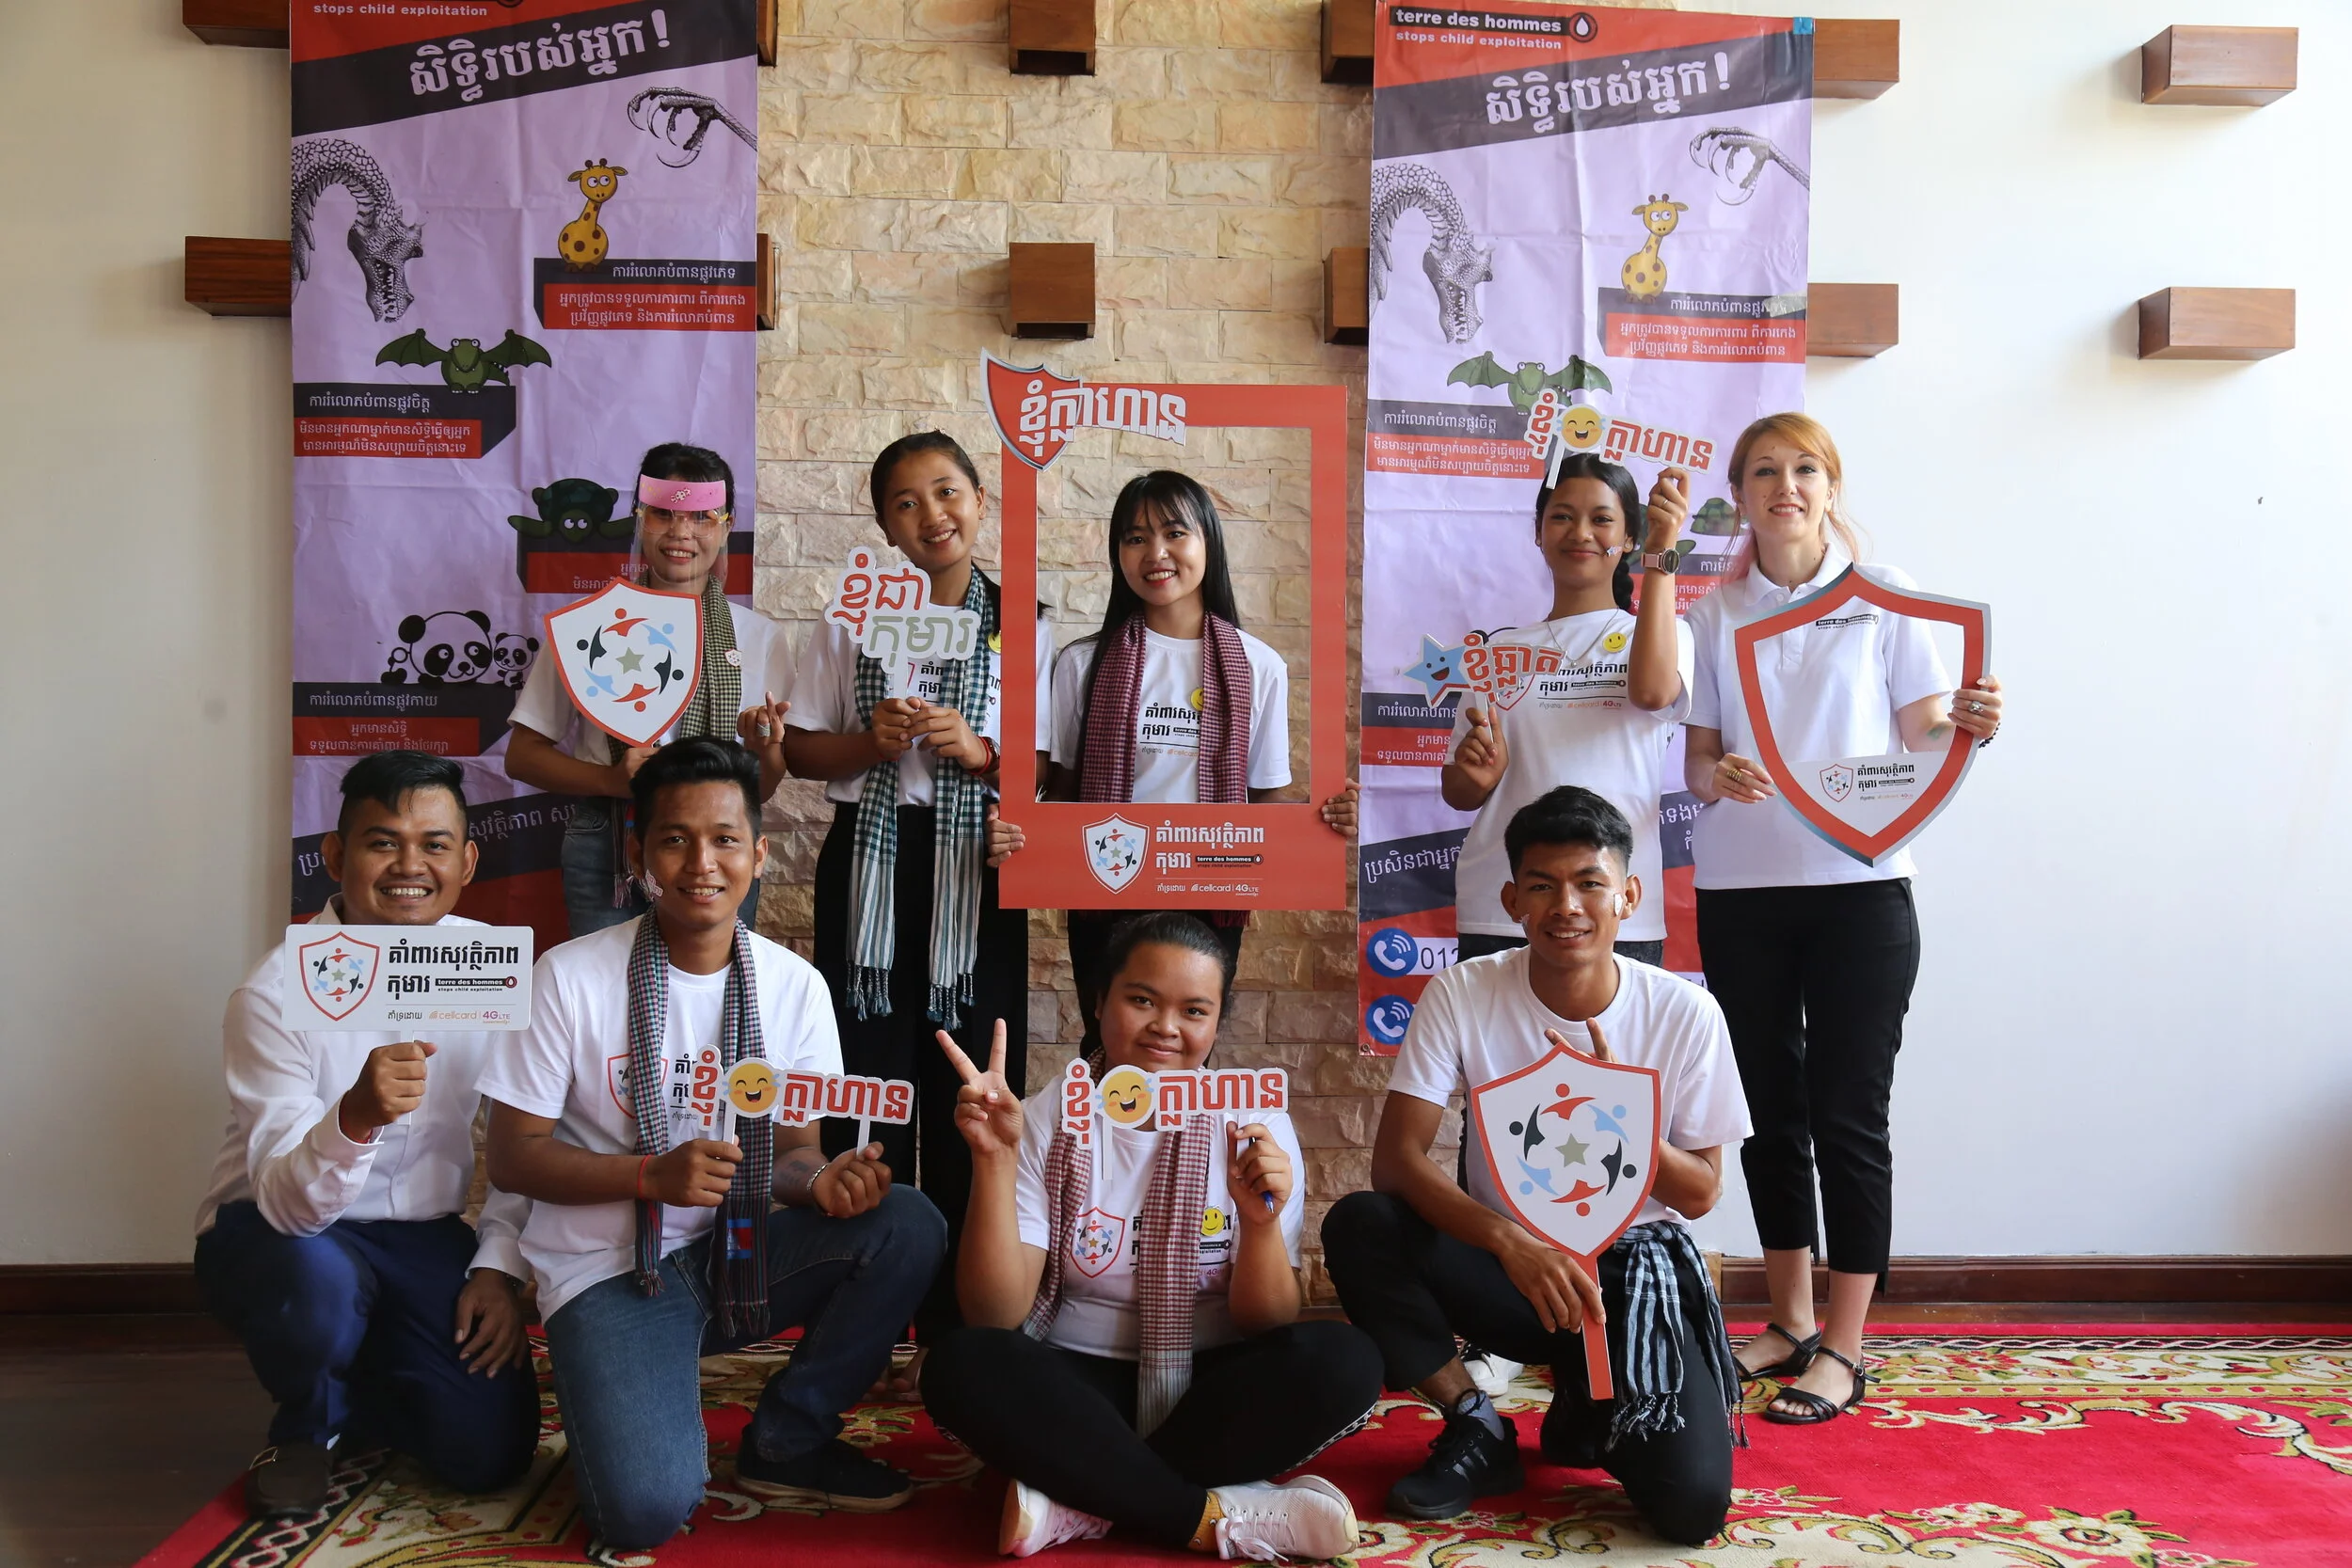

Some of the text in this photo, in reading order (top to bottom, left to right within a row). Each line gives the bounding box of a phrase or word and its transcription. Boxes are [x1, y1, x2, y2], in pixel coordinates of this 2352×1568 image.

[314, 4, 487, 16] stops child exploitation
[1396, 8, 1562, 33] terre des hommes
[1396, 31, 1562, 49] stops child exploitation
[869, 616, 974, 668] កុមារ
[1155, 851, 1192, 875] កុមារ
[387, 974, 430, 1000] កុមារ
[438, 1010, 477, 1020] cellcard
